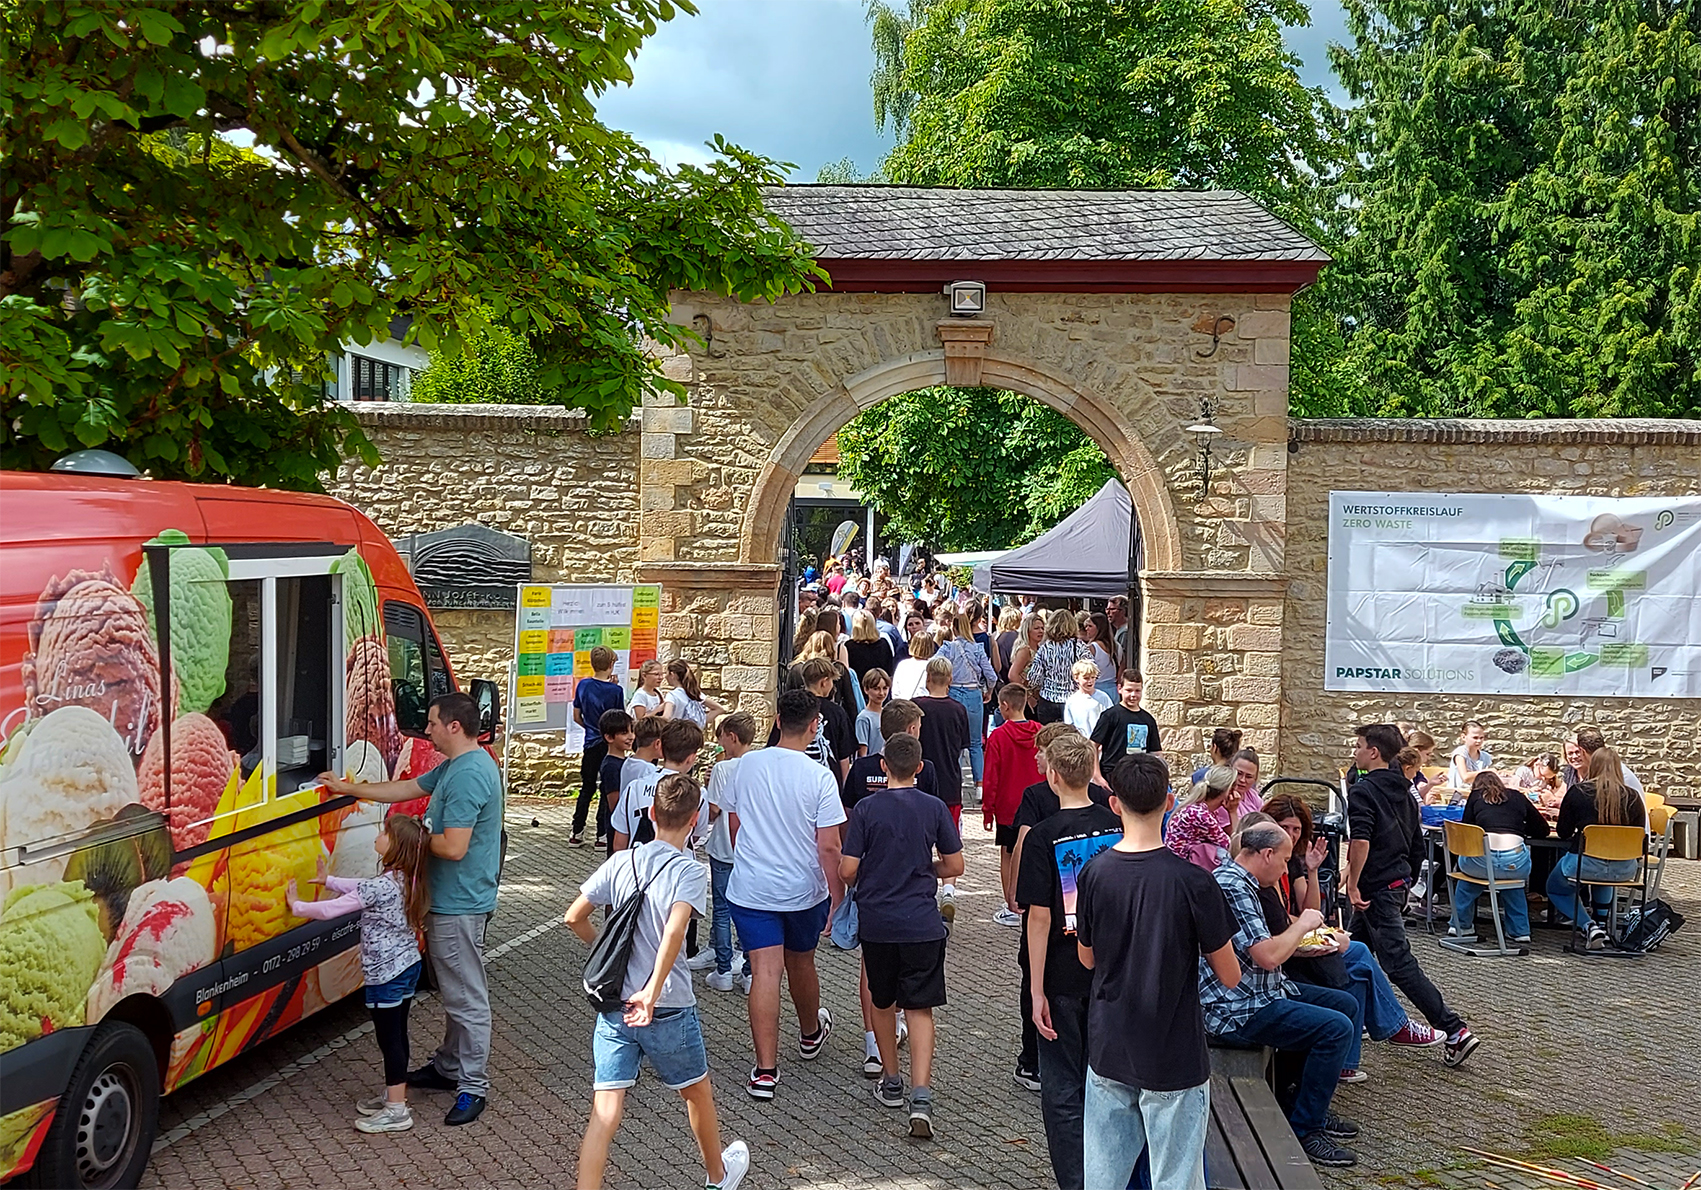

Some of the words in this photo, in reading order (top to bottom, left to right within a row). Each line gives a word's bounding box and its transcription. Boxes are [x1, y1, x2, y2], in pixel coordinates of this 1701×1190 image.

[1343, 505, 1463, 516] WERTSTOFFKREISLAUF
[1343, 519, 1371, 528] ZERO
[1375, 520, 1412, 529] WASTE
[1336, 667, 1401, 679] PAPSTAR
[1404, 669, 1475, 680] SOLUTIONS
[35, 659, 106, 705] Linas
[196, 971, 249, 1005] Blankenheim
[262, 955, 281, 973] 0172
